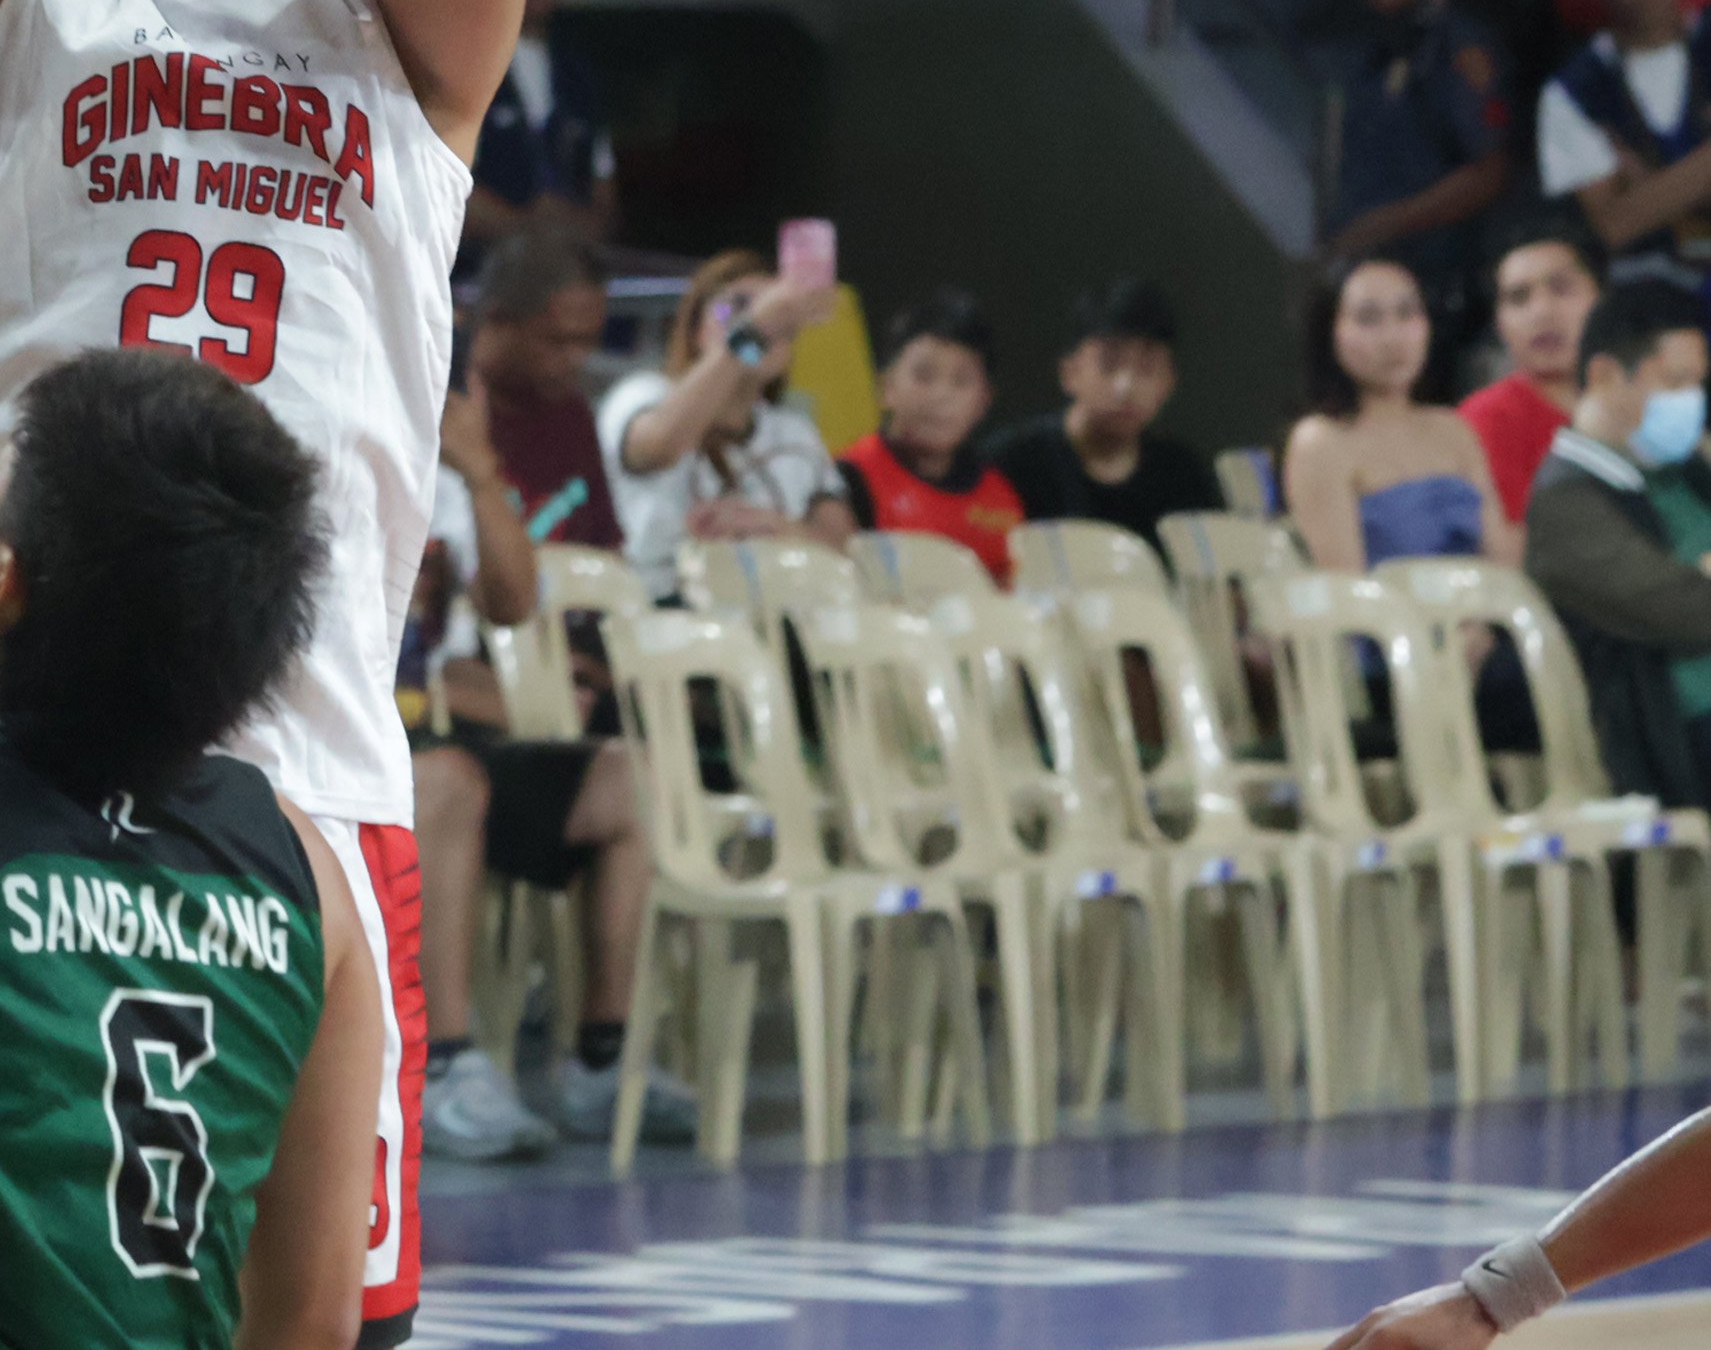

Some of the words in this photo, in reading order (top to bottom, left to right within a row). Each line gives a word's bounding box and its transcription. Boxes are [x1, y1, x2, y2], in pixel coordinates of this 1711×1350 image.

[134, 25, 311, 72] BANGAY
[62, 51, 374, 209] GINEBRA
[88, 152, 180, 204] SAN
[195, 159, 346, 231] MIGUEL
[119, 229, 286, 385] 29
[2, 873, 289, 974] SANGALANG
[99, 987, 217, 1281] 6
